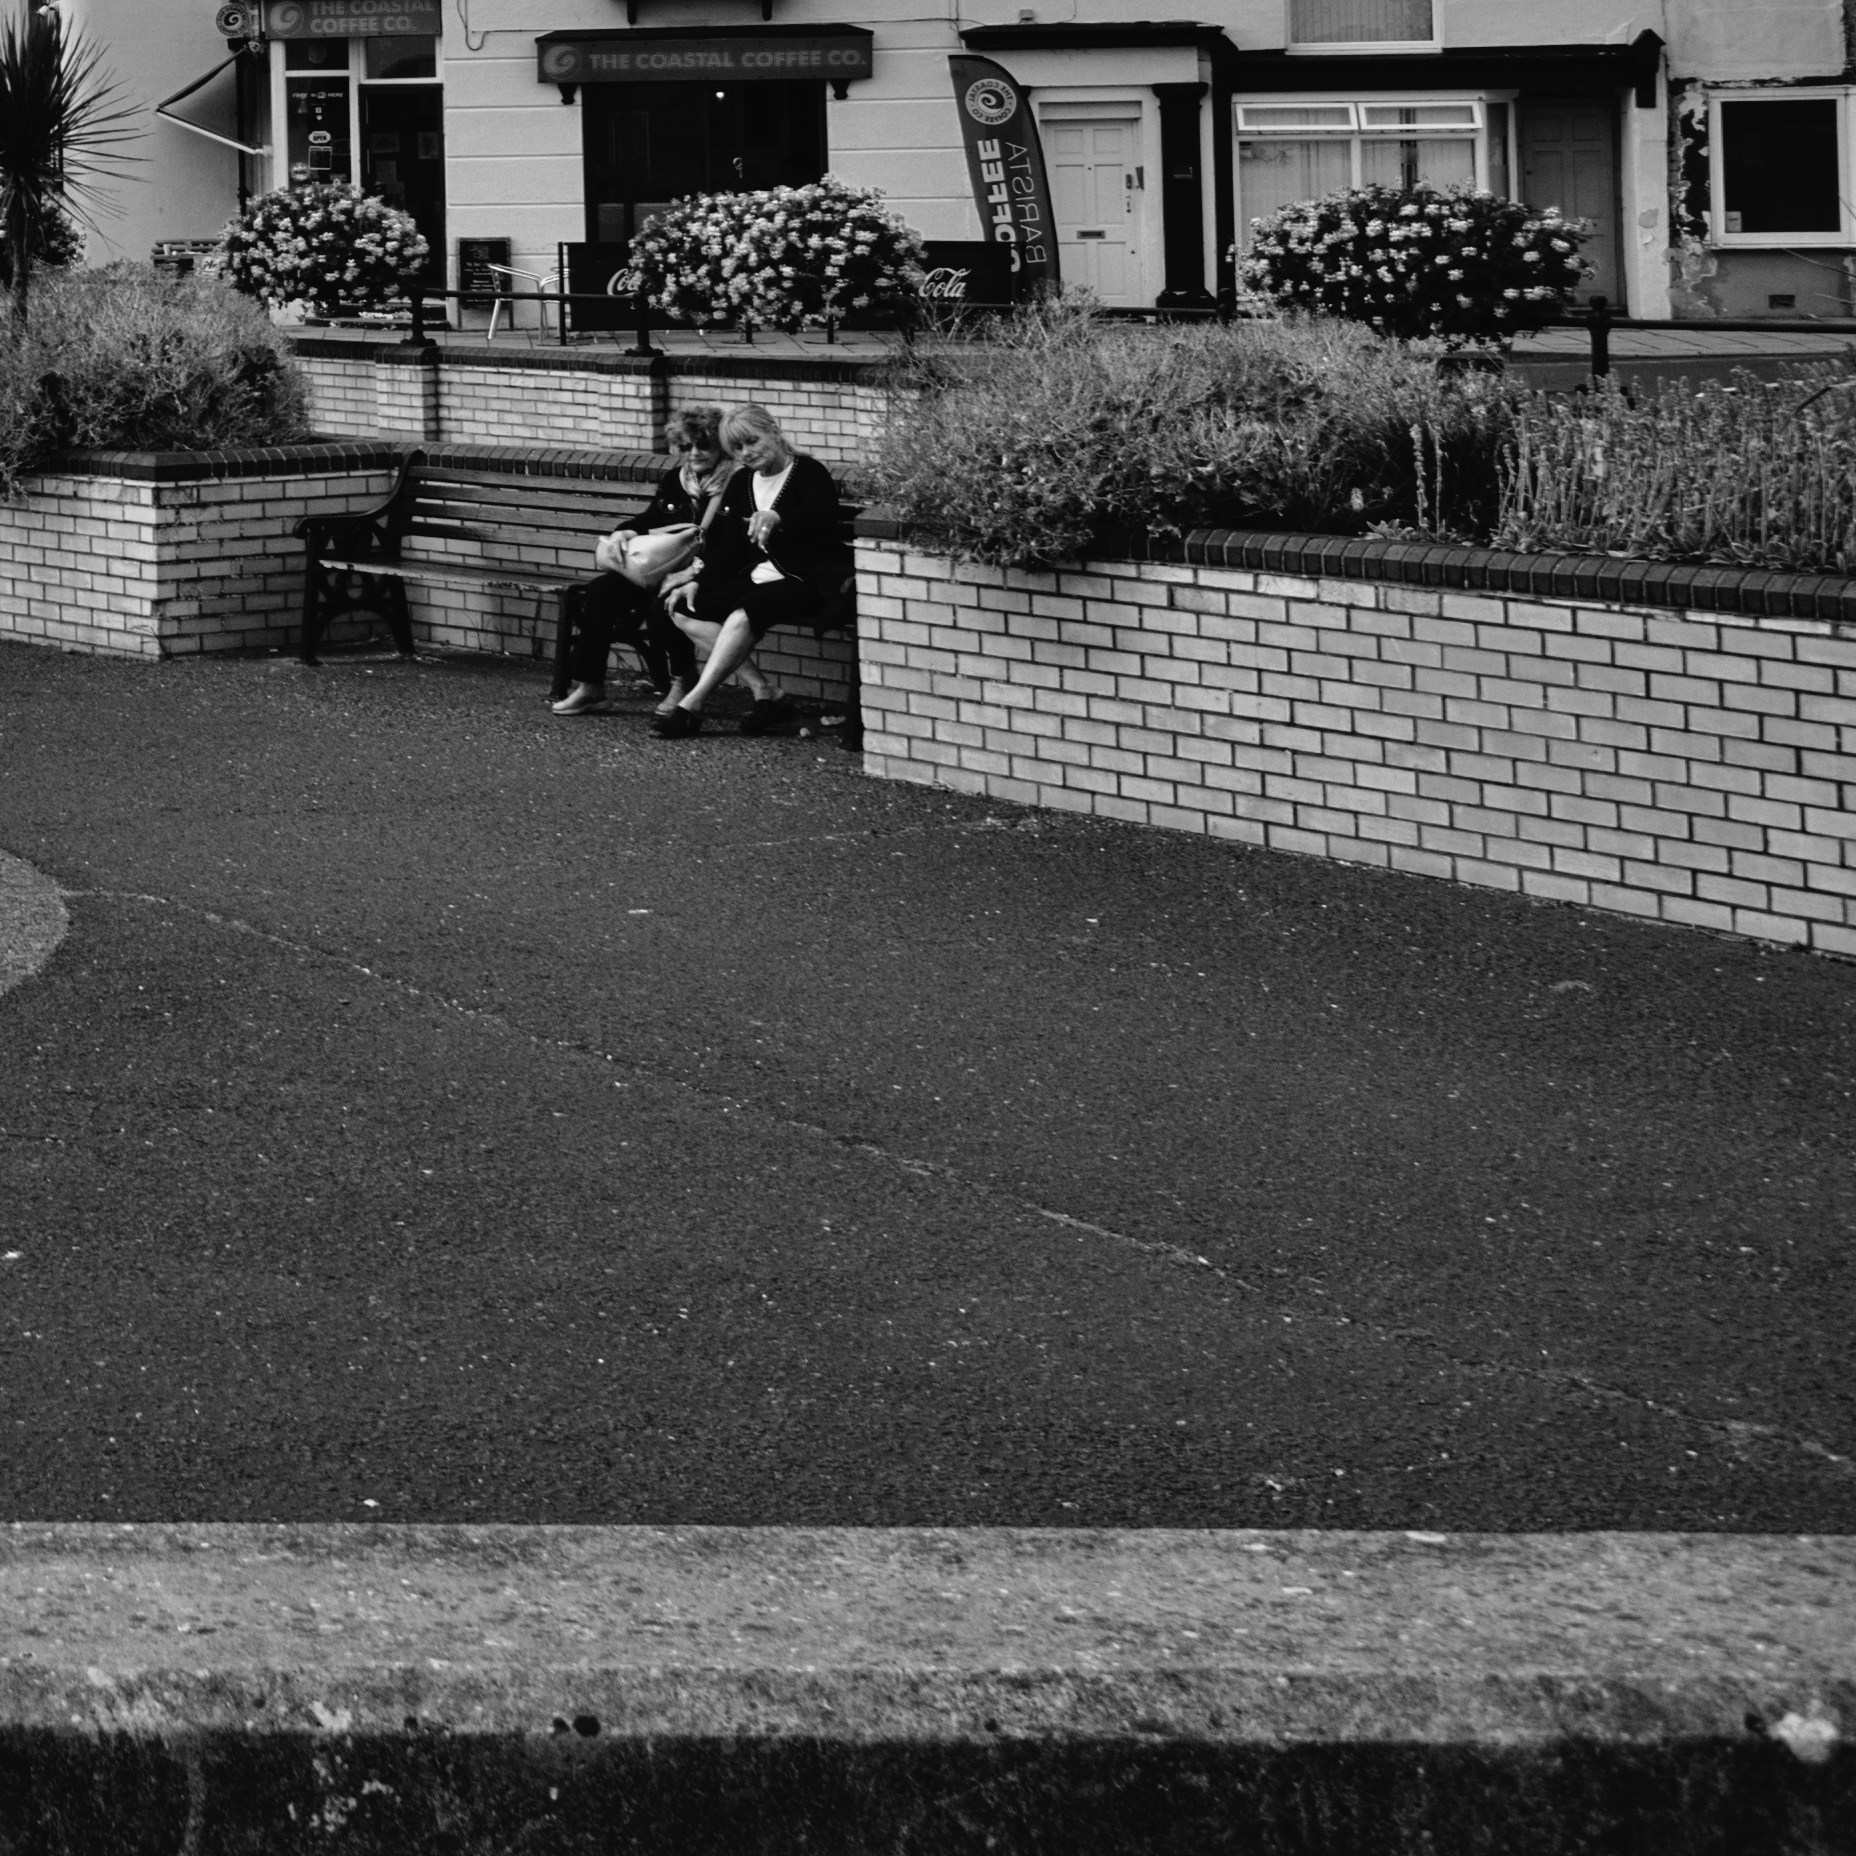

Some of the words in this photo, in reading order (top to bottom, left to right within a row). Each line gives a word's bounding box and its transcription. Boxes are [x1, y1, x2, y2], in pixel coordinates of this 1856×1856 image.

[311, 1, 345, 16] THE
[310, 17, 379, 33] COFFEE
[589, 54, 630, 70] THE
[636, 51, 735, 69] COASTAL
[741, 50, 822, 67] COFFEE
[828, 49, 867, 66] CO.
[918, 267, 972, 298] Cola
